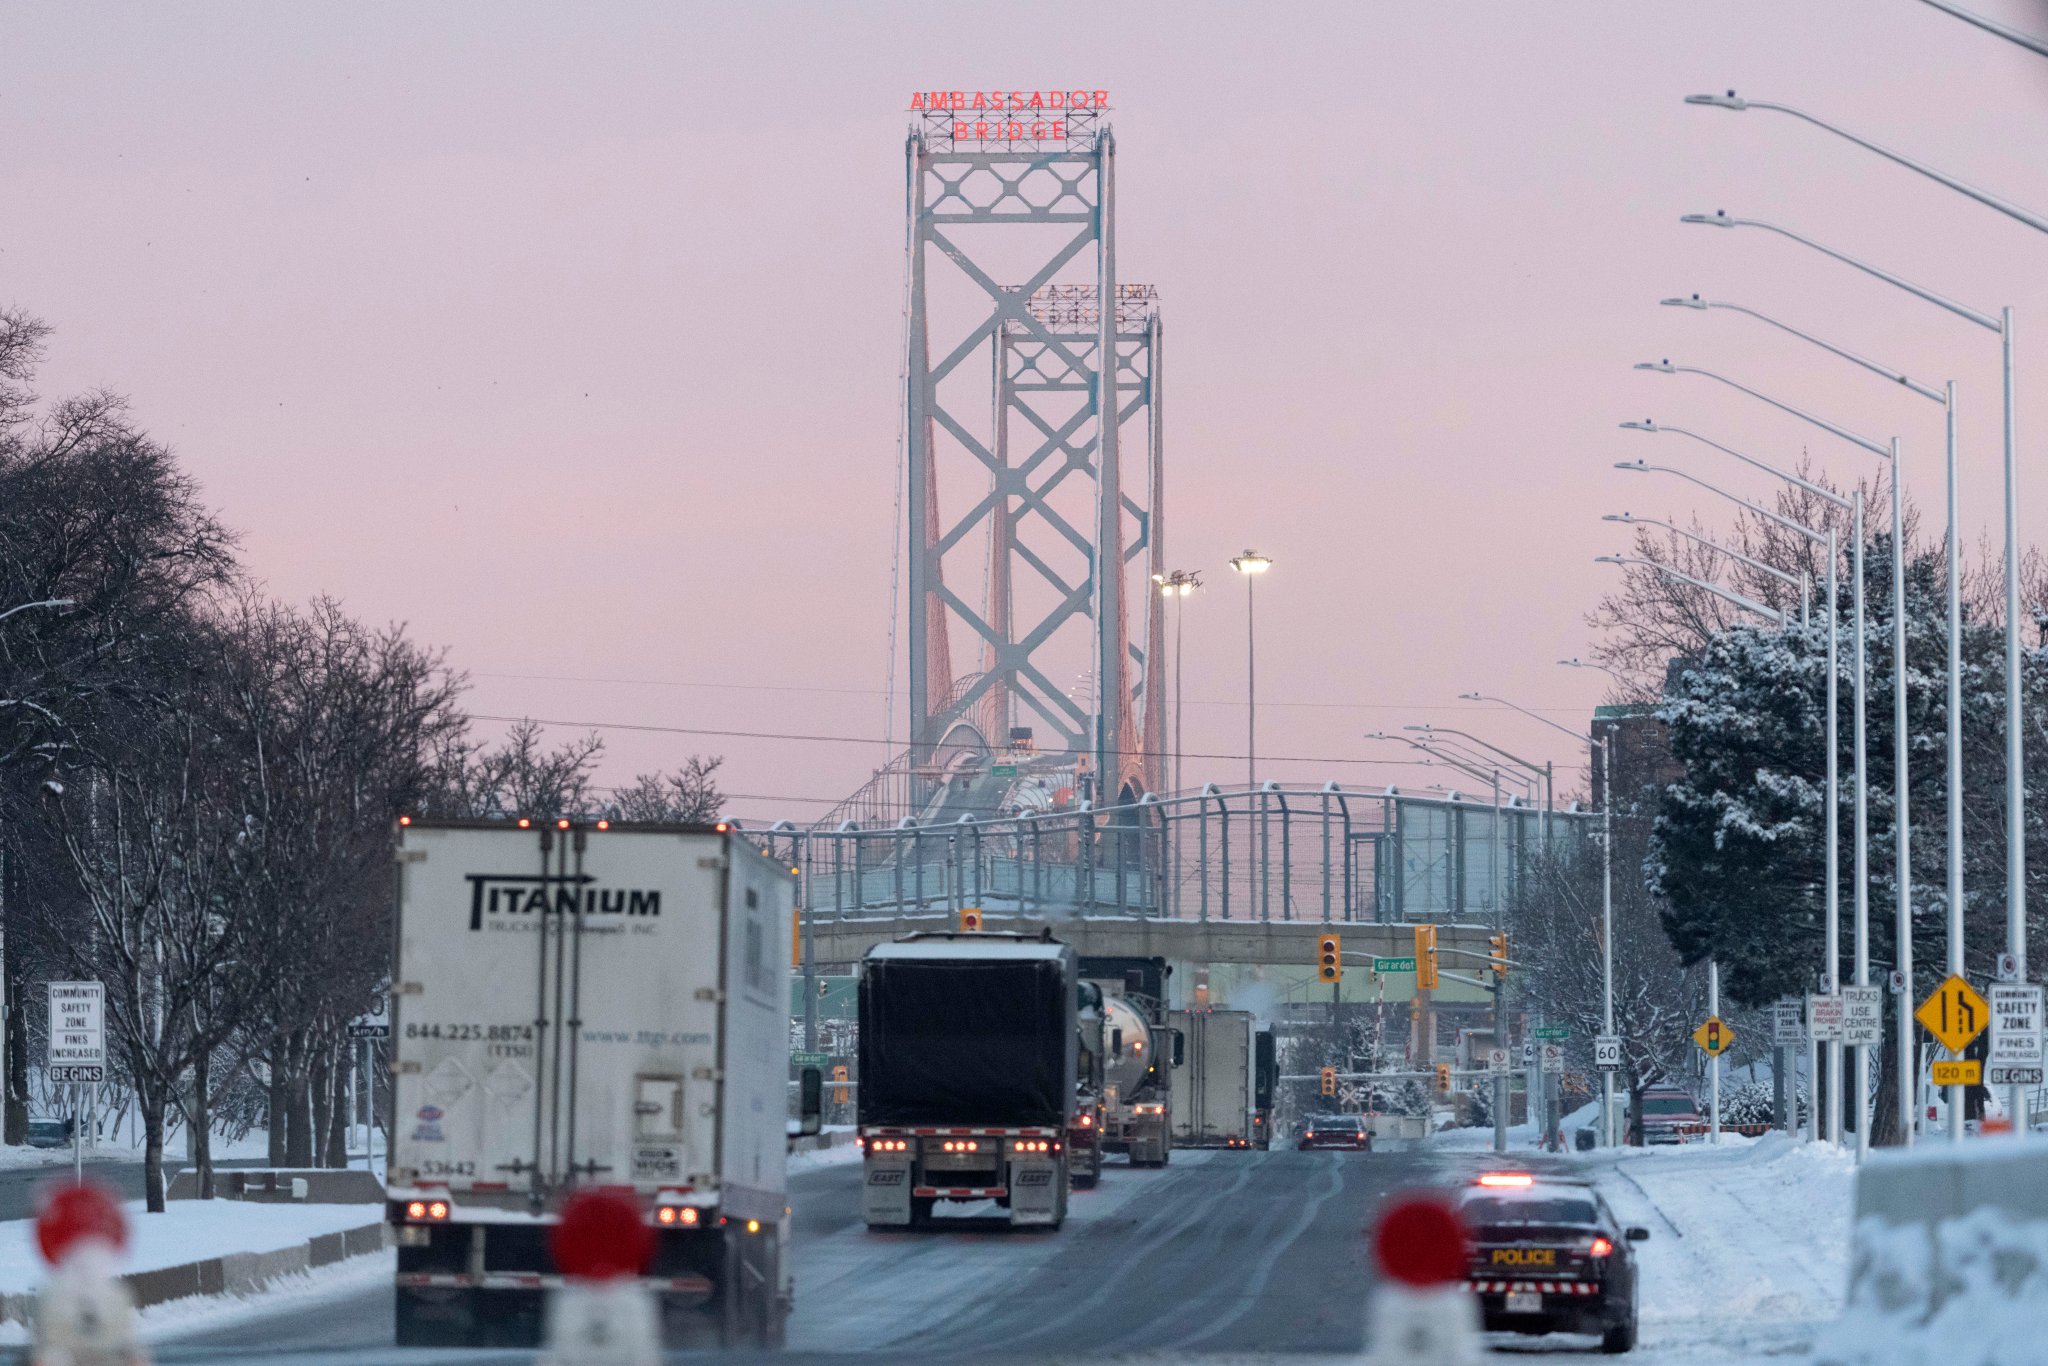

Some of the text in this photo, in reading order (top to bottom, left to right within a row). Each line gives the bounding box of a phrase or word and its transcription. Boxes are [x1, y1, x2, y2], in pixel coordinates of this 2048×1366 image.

[910, 90, 1108, 110] AMBASSADOR
[953, 121, 1066, 140] BRIDGE
[465, 874, 661, 931] TITANIUM
[1378, 960, 1414, 970] Girardot
[53, 989, 99, 998] COMMUNITY
[1845, 991, 1878, 1000] TRUCKS
[1995, 990, 2038, 998] COMMUNITY
[61, 1003, 91, 1012] SAFETY
[1851, 1006, 1871, 1016] USE
[1996, 1002, 2037, 1014] SAFETY
[65, 1017, 86, 1027] ZONE
[1844, 1018, 1877, 1028] CENTRE
[2002, 1016, 2030, 1029] ZONE
[406, 1022, 533, 1041] 844.225.8874
[1849, 1030, 1872, 1039] LANE
[65, 1035, 88, 1045] FINES
[1999, 1037, 2034, 1047] FINES
[53, 1049, 99, 1058] INCREASED
[1598, 1046, 1616, 1059] 60
[52, 1068, 101, 1080] BEGINS
[1937, 1067, 1974, 1079] 120 m
[1992, 1069, 2042, 1083] BEGINS
[873, 1174, 900, 1182] EAST
[1021, 1174, 1047, 1182] EAST
[1492, 1249, 1555, 1265] POLICE
